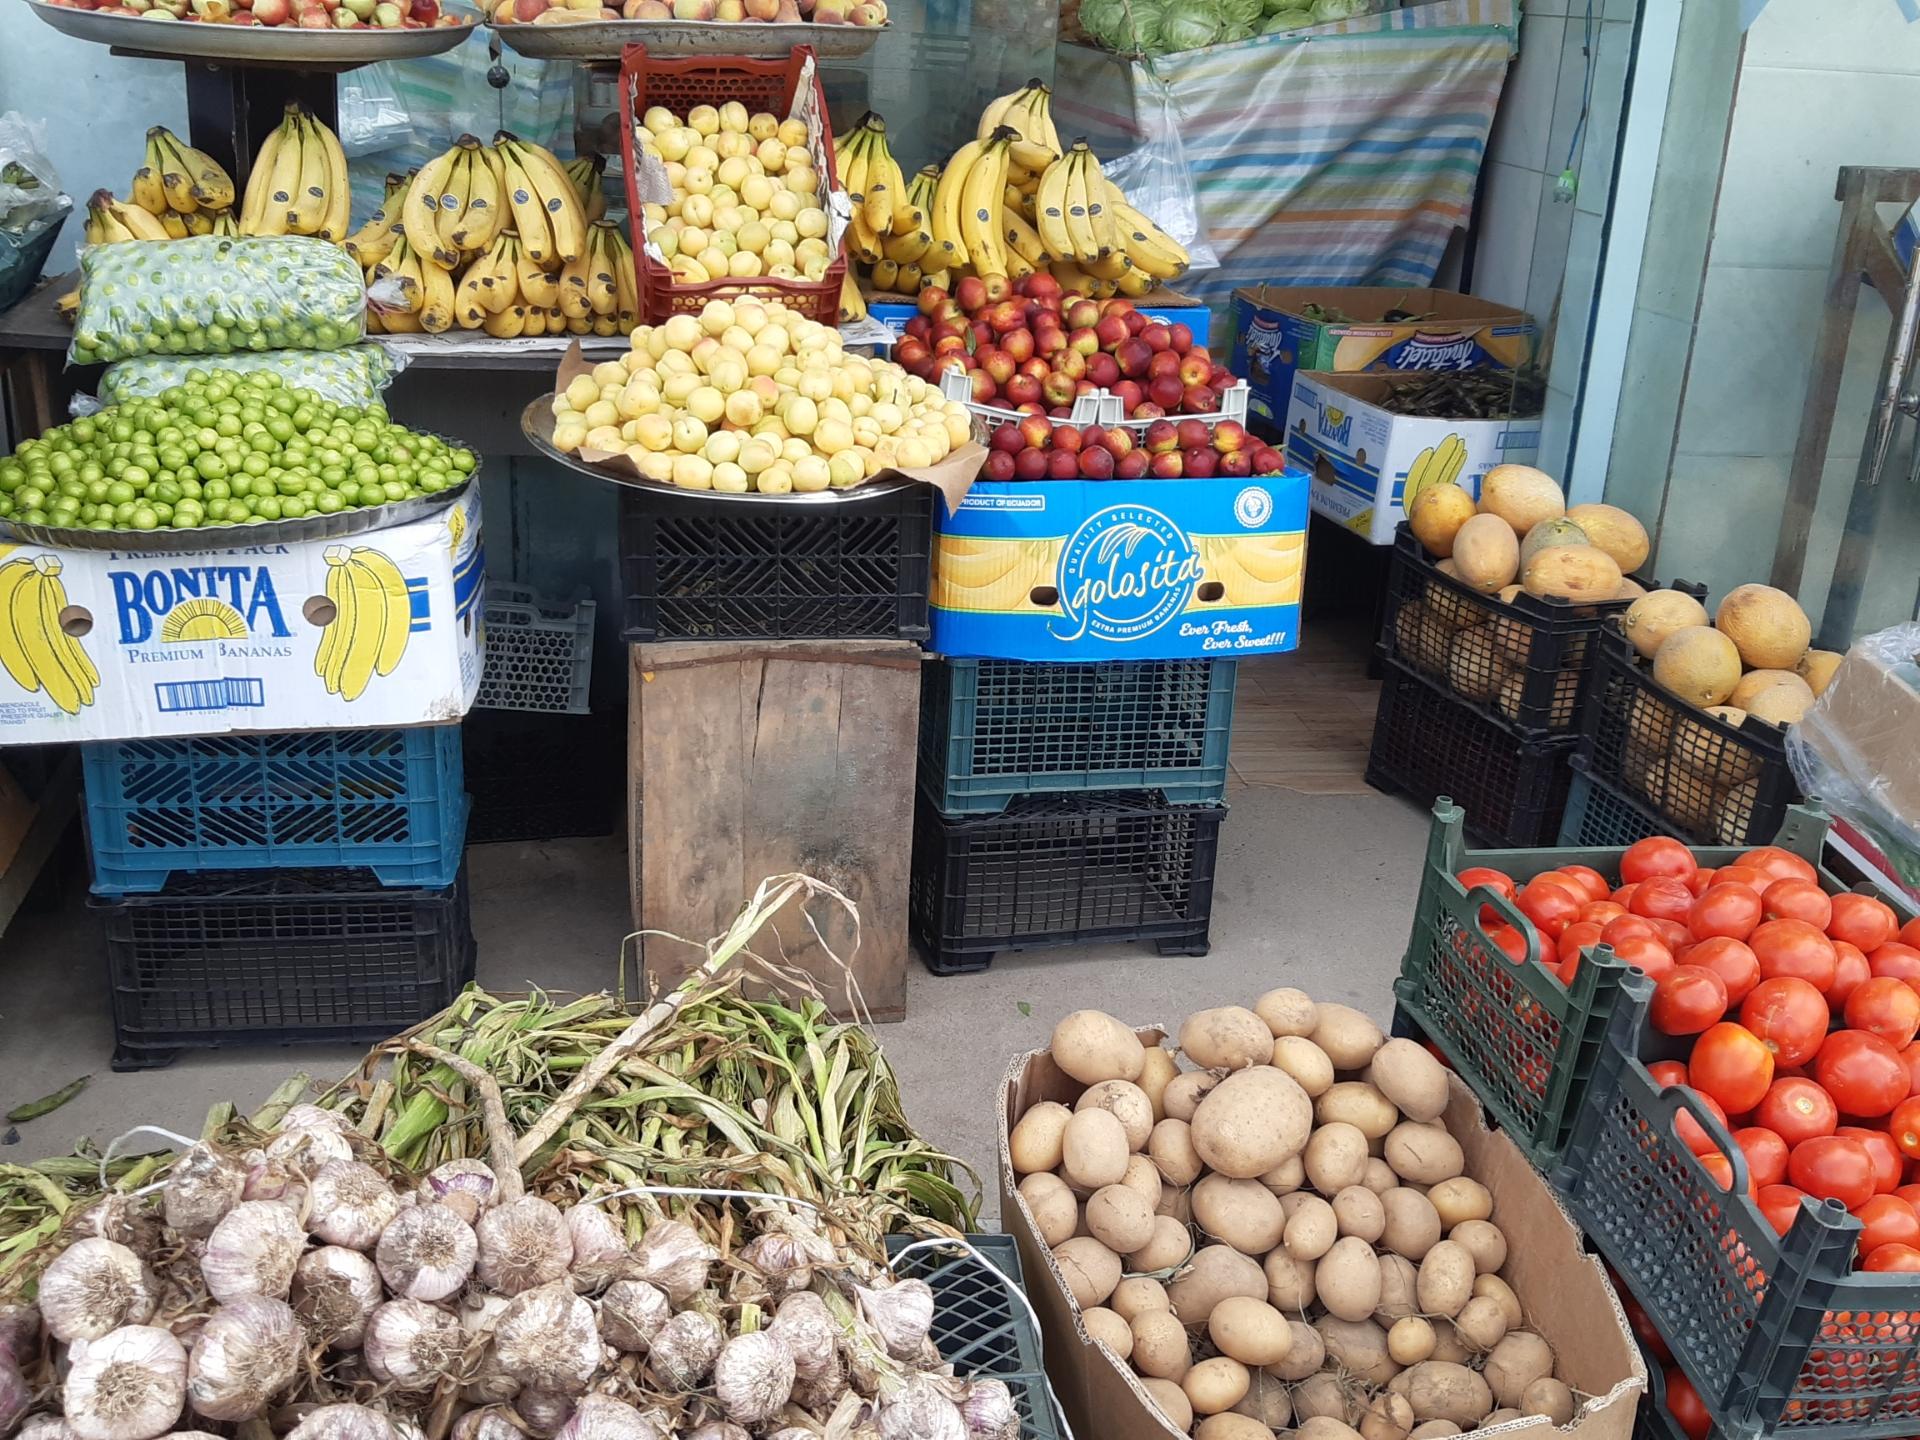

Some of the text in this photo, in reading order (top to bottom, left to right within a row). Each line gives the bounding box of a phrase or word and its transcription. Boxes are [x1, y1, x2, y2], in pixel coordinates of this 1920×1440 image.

[1317, 402, 1353, 447] BONITA
[1068, 512, 1174, 574] QUALITY SELECTED
[107, 566, 293, 645] BONITA
[1047, 550, 1204, 641] golosita
[1091, 587, 1182, 634] EXTRA PREMIUM BANANAS
[1179, 619, 1253, 637] Ever Fresh,
[1202, 631, 1287, 650] Ever Sweet!!!
[128, 643, 292, 664] PREMIUM BANANAS
